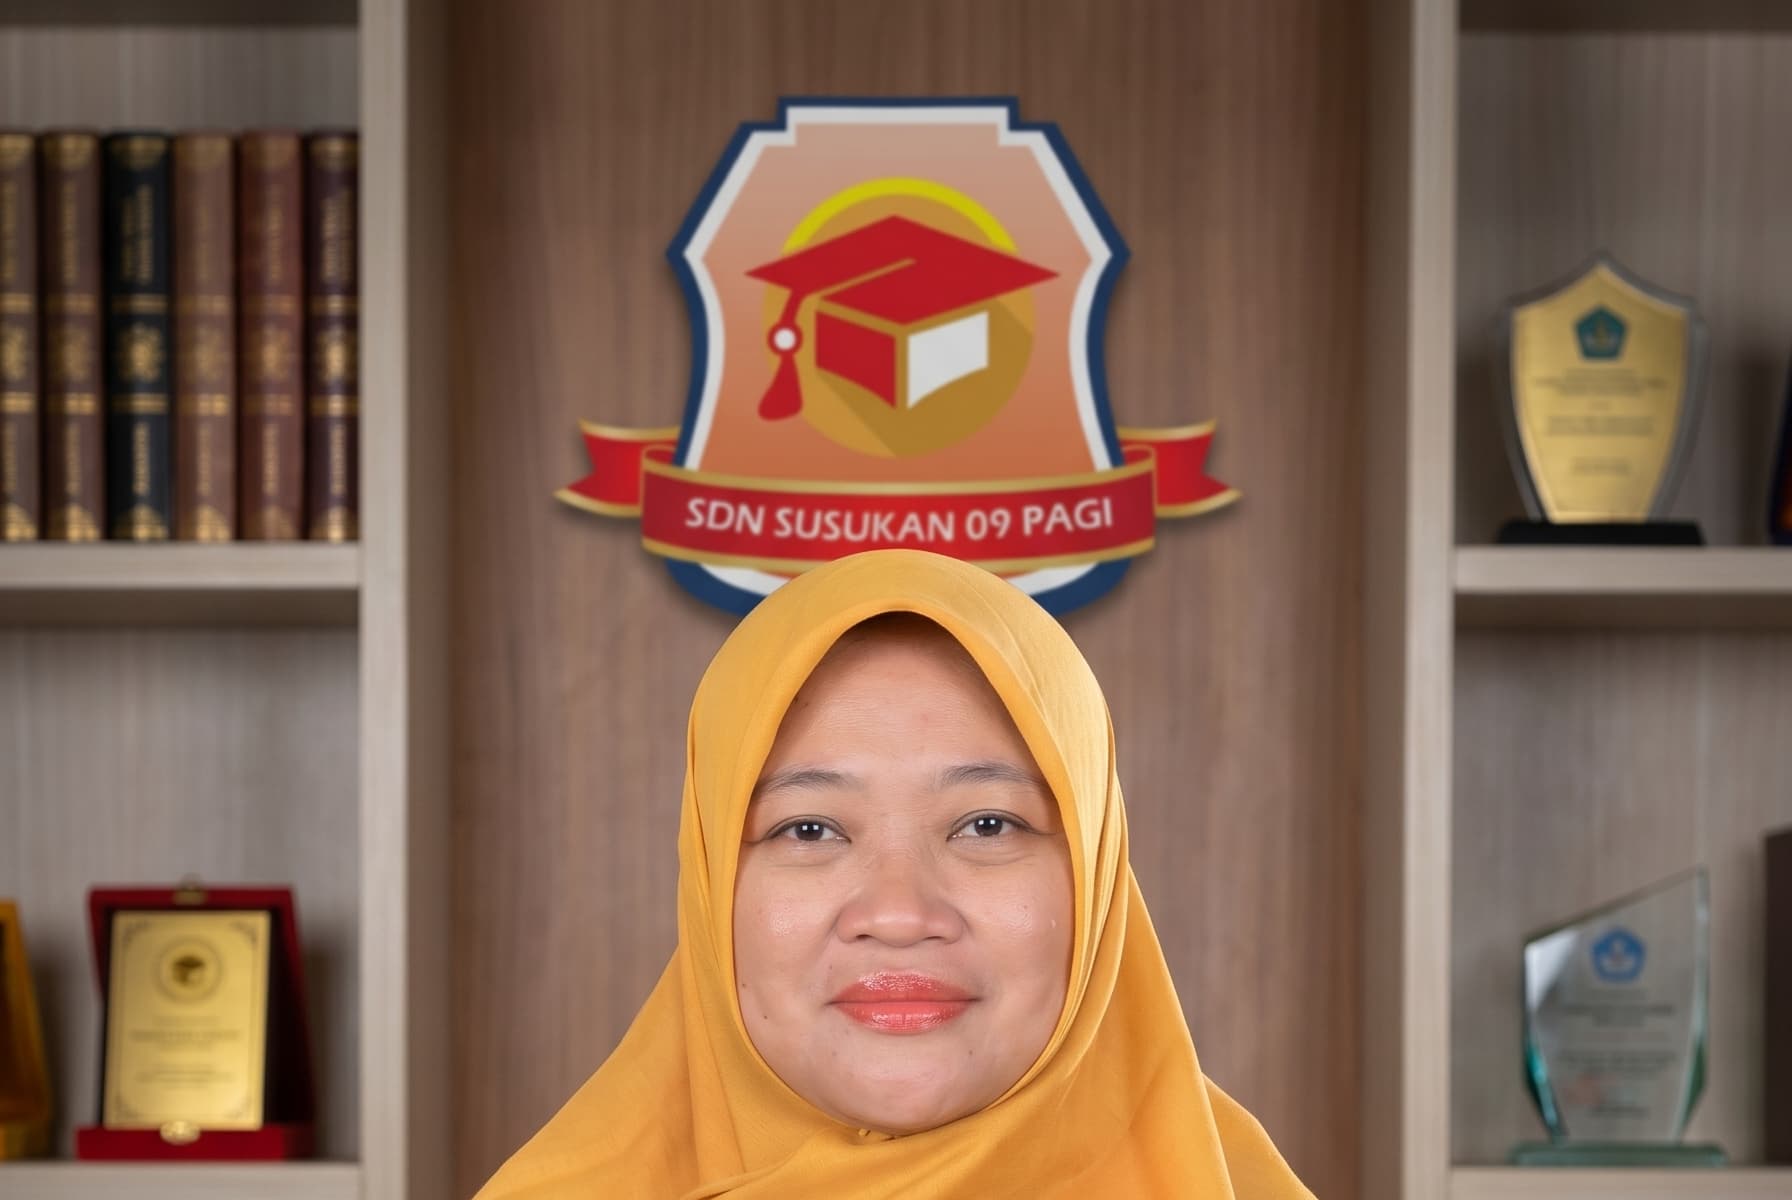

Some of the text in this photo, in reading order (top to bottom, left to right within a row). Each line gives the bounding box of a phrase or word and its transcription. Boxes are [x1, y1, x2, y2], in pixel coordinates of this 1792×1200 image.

[685, 497, 1113, 542] SDN SUSUKAN 09 PAGI
